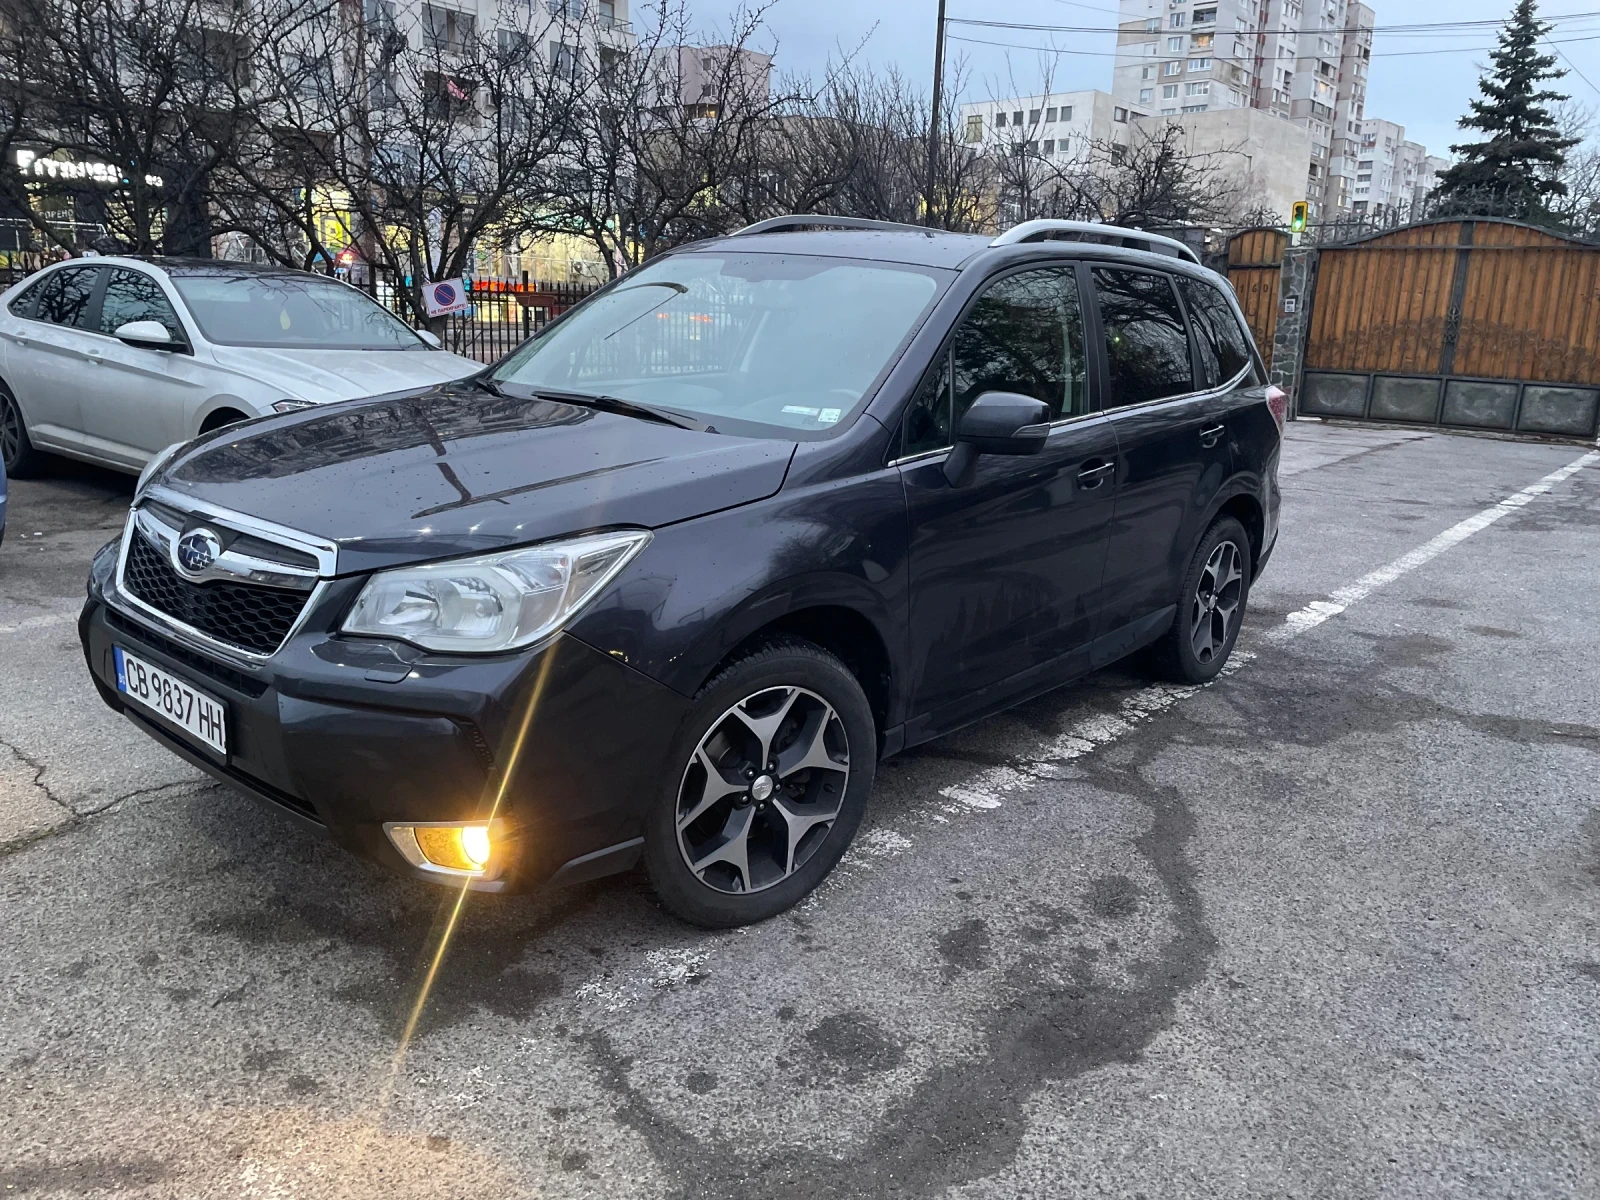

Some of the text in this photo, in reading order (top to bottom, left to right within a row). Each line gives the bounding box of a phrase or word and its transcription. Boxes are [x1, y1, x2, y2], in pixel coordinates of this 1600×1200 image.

[126, 658, 223, 747] CB 9837 HH
